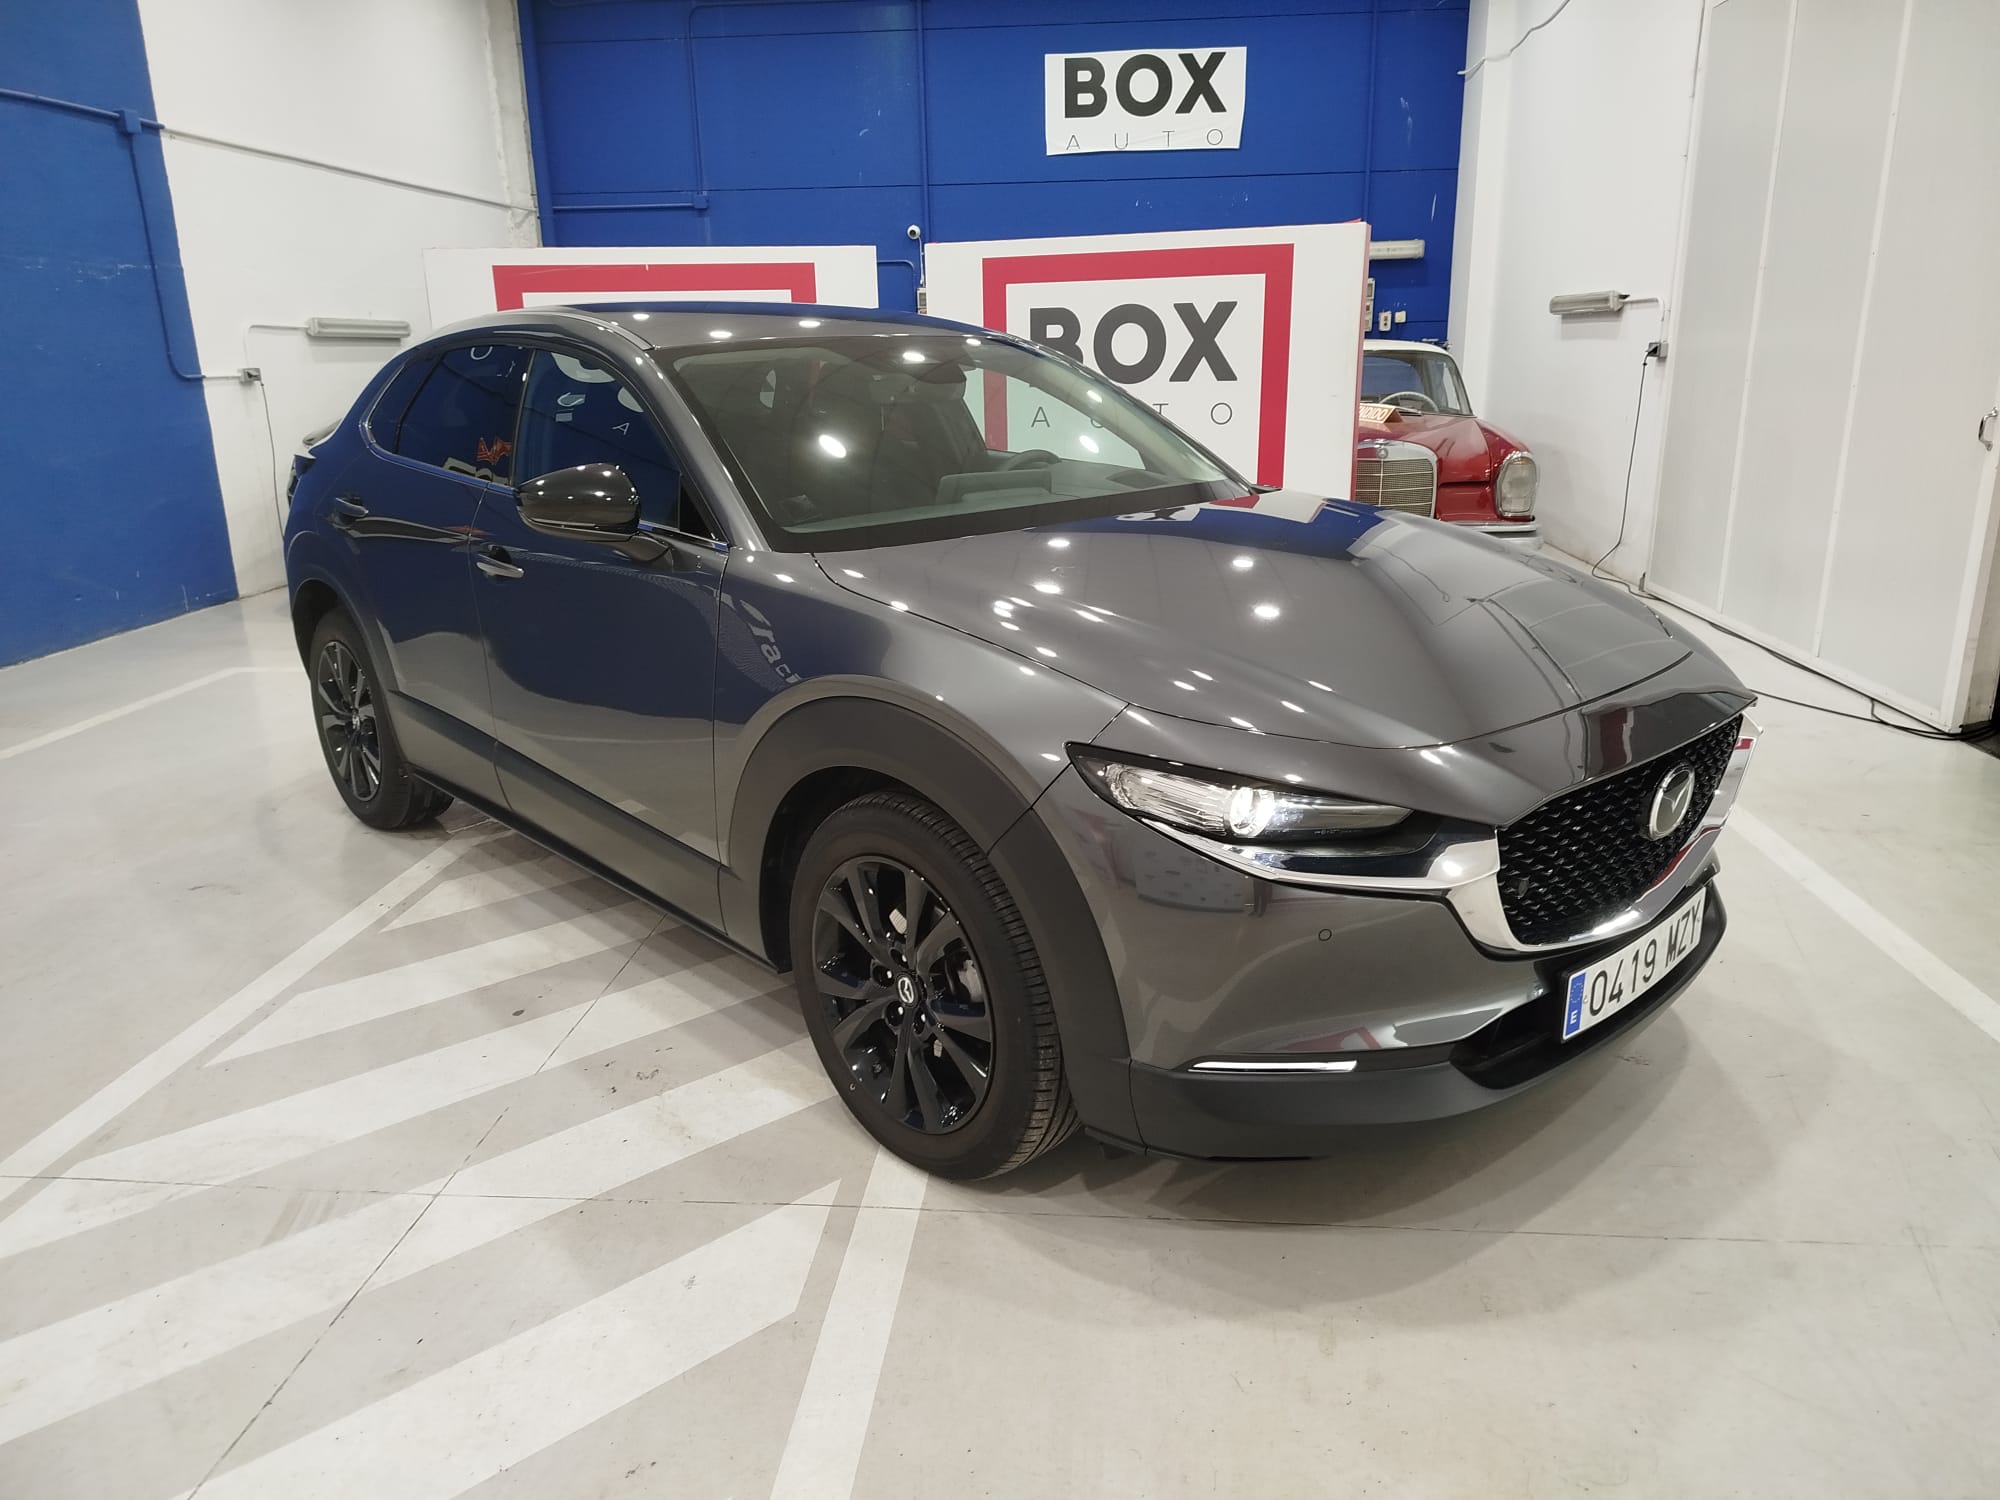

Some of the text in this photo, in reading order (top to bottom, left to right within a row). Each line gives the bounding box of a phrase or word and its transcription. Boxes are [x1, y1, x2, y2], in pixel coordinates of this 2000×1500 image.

[1064, 52, 1227, 119] BOX
[1065, 128, 1224, 150] AUTO
[1029, 301, 1238, 384] BOX
[1589, 899, 1702, 1017] 0419 MZY
[1569, 1009, 1579, 1025] E
